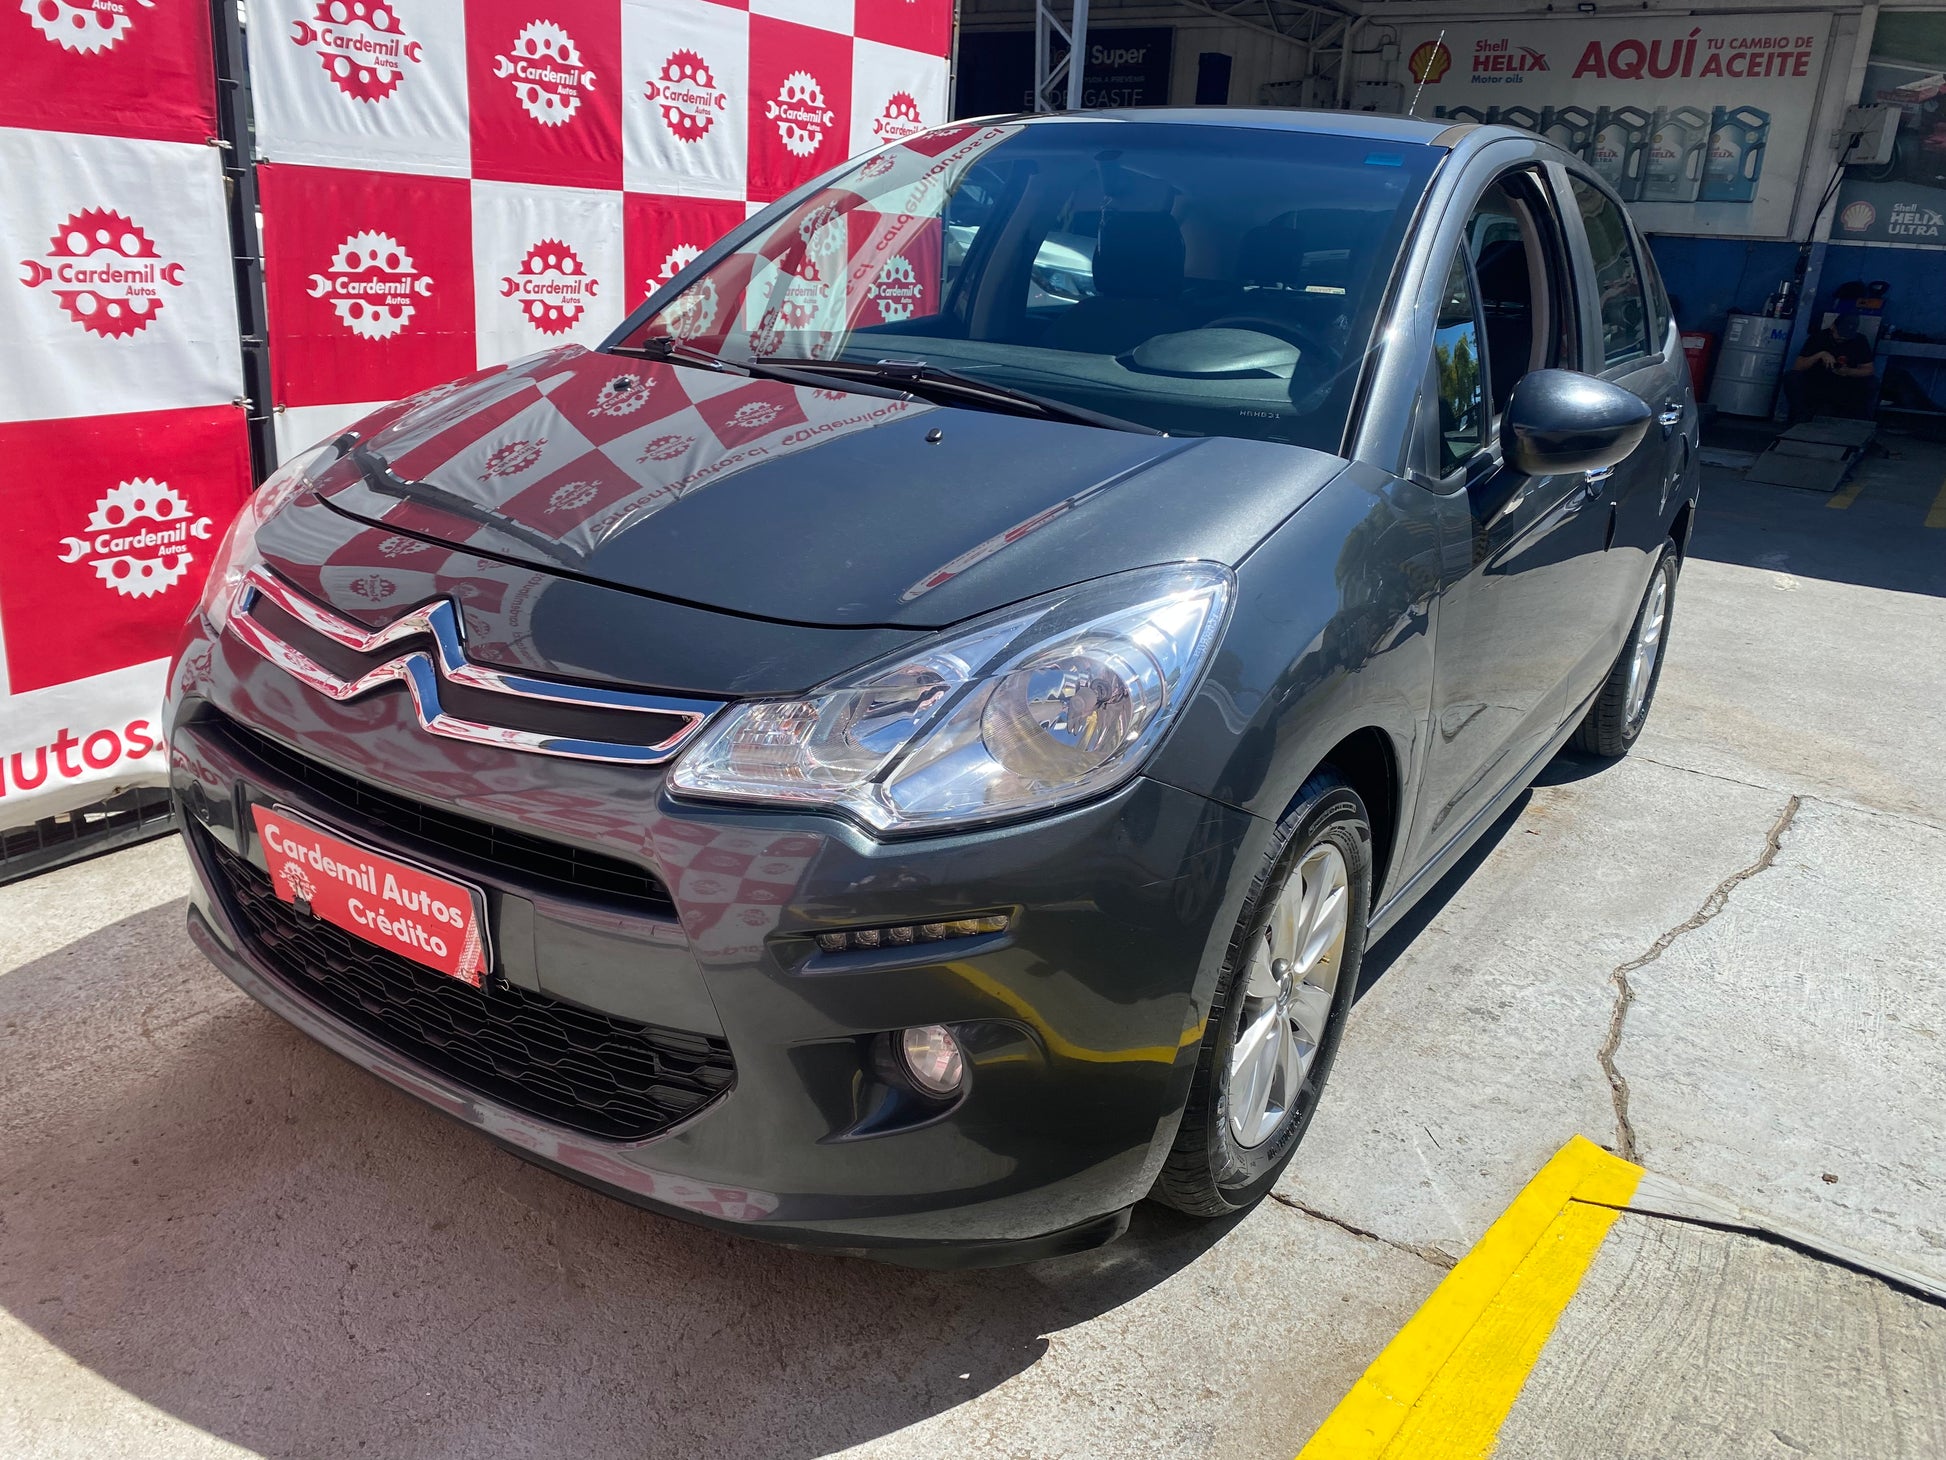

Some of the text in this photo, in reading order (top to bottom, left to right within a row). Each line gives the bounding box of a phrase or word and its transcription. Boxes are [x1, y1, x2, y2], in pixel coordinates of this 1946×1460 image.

[92, 0, 124, 13] Autos
[321, 28, 399, 57] Cardemil
[1475, 39, 1509, 52] Shell
[1707, 36, 1814, 49] TU CAMBIO DE
[1092, 45, 1146, 68] Super
[1473, 47, 1550, 72] HELIX
[1572, 27, 1702, 80] AQUÍ
[374, 56, 399, 68] Autos
[1700, 51, 1811, 78] ACEITE
[516, 61, 579, 85] Cardemil
[1471, 73, 1523, 84] Motor oils
[557, 85, 577, 96] Autos
[662, 86, 712, 106] Cardemil
[694, 106, 712, 116] Autos
[780, 104, 822, 124] Cardemil
[806, 123, 821, 132] Autos
[1893, 203, 1918, 212] Shell
[1890, 209, 1945, 226] HELIX
[1888, 224, 1938, 236] ULTRA
[57, 262, 155, 285] Cardemil
[125, 285, 156, 297] Autos
[335, 276, 411, 295] Cardemil
[523, 279, 581, 295] Cardemil
[785, 284, 818, 297] ardemil
[880, 285, 913, 297] Cardemil
[385, 295, 410, 305] Autos
[561, 296, 581, 304] Autos
[94, 522, 186, 553] Cardemil
[158, 543, 187, 556] Autos
[264, 823, 377, 896] Cardemil
[382, 873, 464, 929] Autos
[348, 897, 448, 958] Crédito
